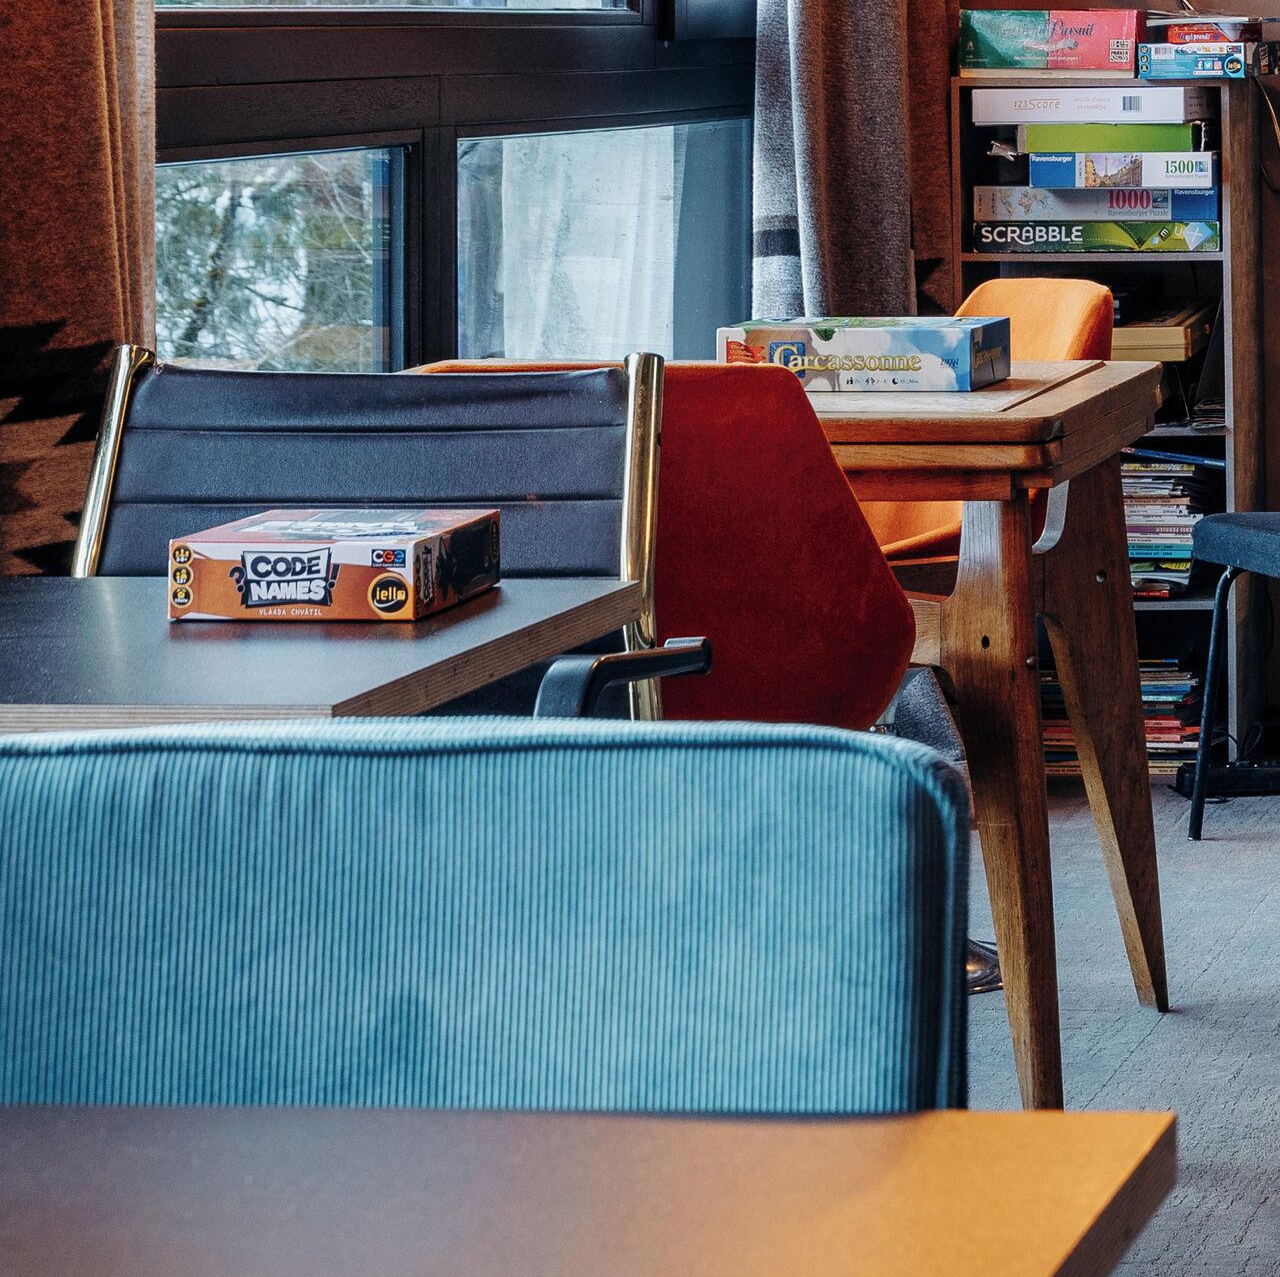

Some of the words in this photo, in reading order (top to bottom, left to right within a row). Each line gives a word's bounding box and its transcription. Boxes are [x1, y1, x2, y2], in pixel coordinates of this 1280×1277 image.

[1031, 155, 1073, 164] Ravensburger
[1164, 160, 1194, 174] 1500
[1107, 189, 1151, 210] 1000
[1108, 209, 1149, 217] Ravensburger
[981, 225, 1083, 245] SCRABBLE
[773, 345, 922, 372] Carcassonne
[250, 555, 321, 578] CODE
[250, 579, 326, 602] NAMES
[376, 586, 406, 601] iello
